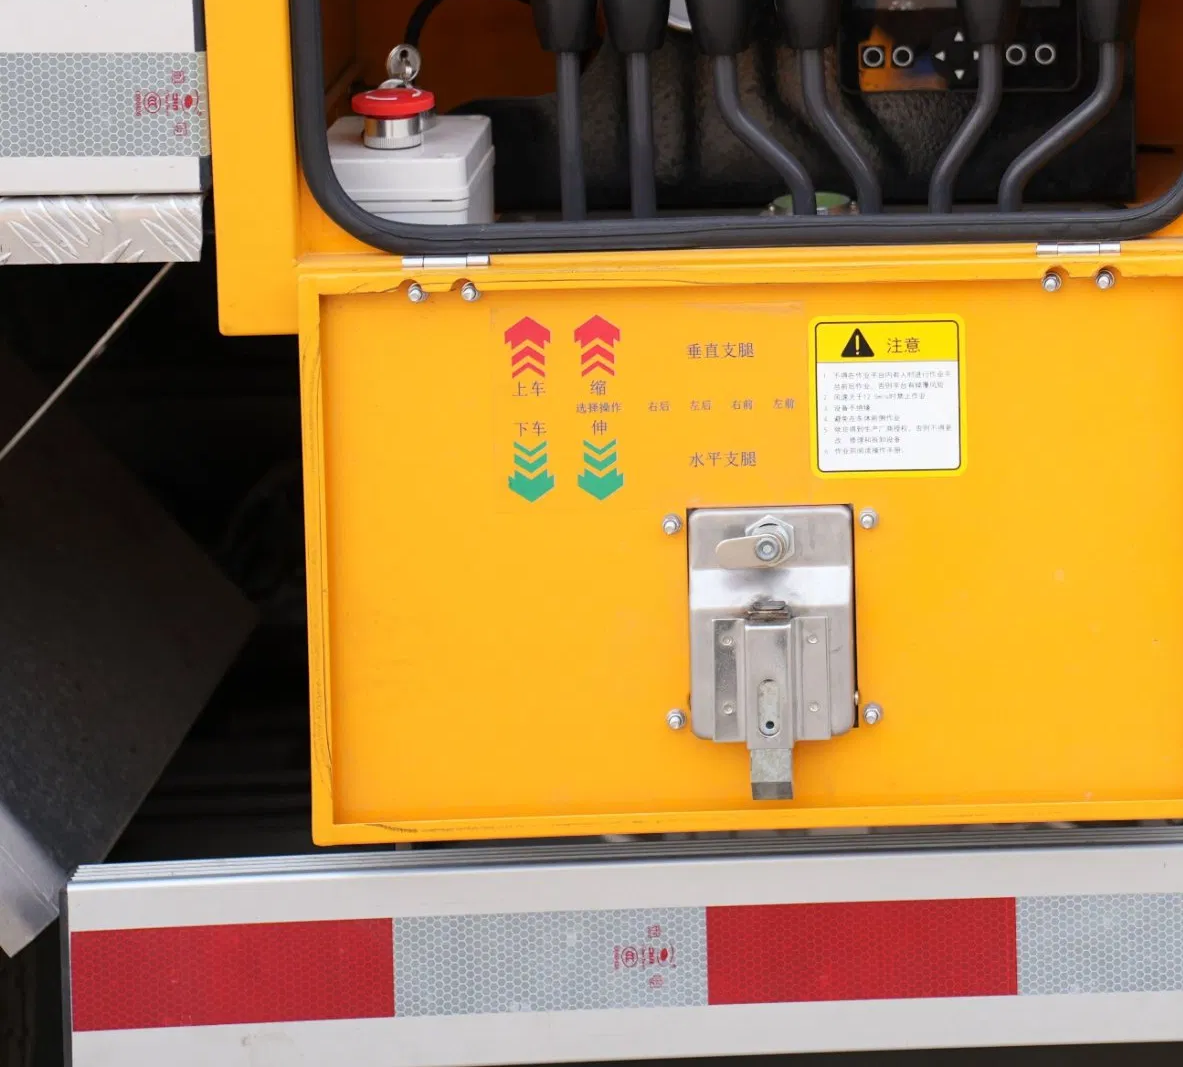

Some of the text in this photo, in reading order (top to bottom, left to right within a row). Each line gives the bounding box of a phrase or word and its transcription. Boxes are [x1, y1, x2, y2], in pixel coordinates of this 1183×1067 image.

[686, 342, 755, 360] 垂直支腿
[887, 337, 921, 354] 注意
[512, 380, 546, 397] 上车
[589, 379, 606, 396] 缩
[576, 401, 622, 414] 选择操作
[648, 400, 670, 412] 右后
[690, 399, 712, 411] 左后
[731, 398, 753, 411] 右前
[773, 397, 795, 410] 左前
[513, 420, 547, 437] 下车
[591, 419, 608, 437] 伸
[689, 450, 757, 468] 水平支腿
